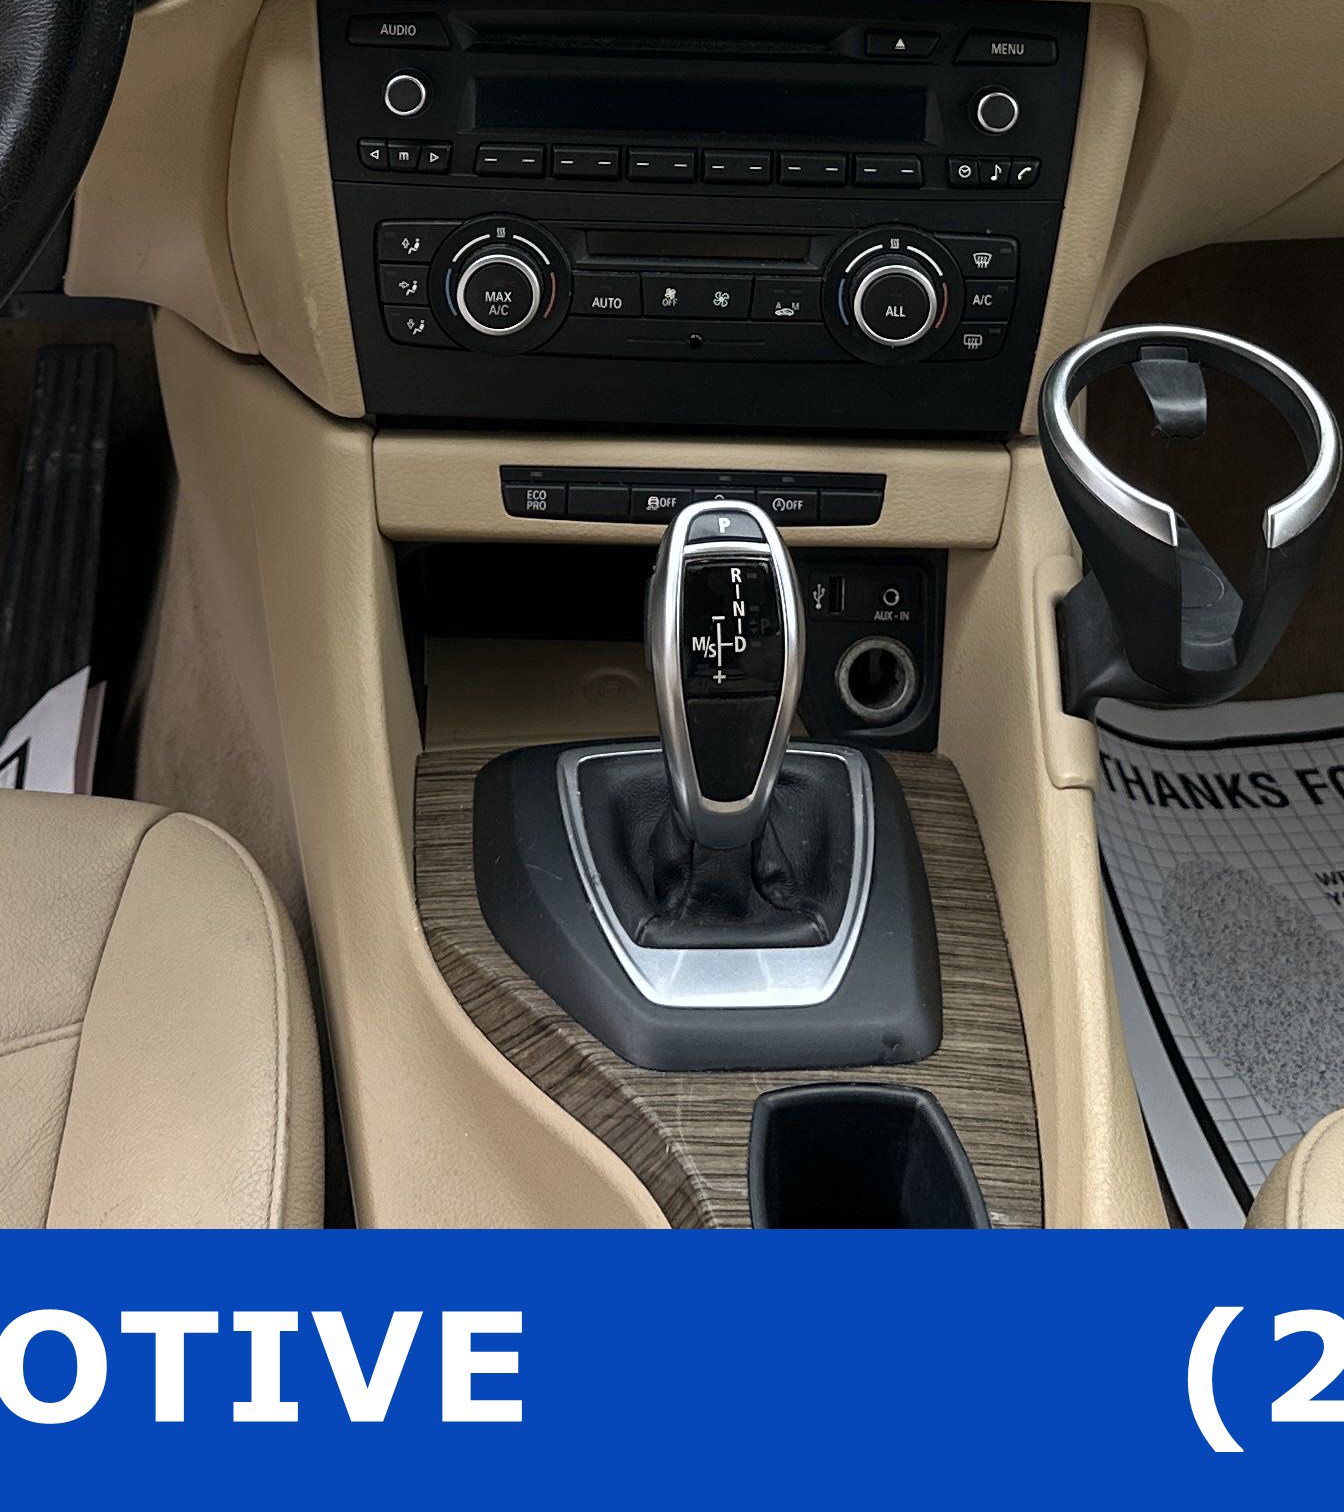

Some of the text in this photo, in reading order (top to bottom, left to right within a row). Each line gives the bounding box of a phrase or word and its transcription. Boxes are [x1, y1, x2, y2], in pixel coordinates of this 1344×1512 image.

[379, 23, 417, 36] AUDIO
[991, 42, 1025, 55] MENU
[484, 291, 512, 303] MAX
[591, 297, 623, 309] AUTO
[661, 298, 677, 307] OFF
[972, 294, 993, 306] A/C
[488, 304, 509, 316] A/C
[885, 305, 907, 317] ALL
[526, 489, 547, 500] ECO
[526, 500, 547, 511] PRO
[658, 497, 677, 508] OFF
[785, 500, 803, 510] OFF
[718, 517, 731, 534] P
[730, 567, 742, 583] R
[732, 600, 746, 617] N
[734, 635, 747, 653] D
[1099, 751, 1291, 810] THANKS
